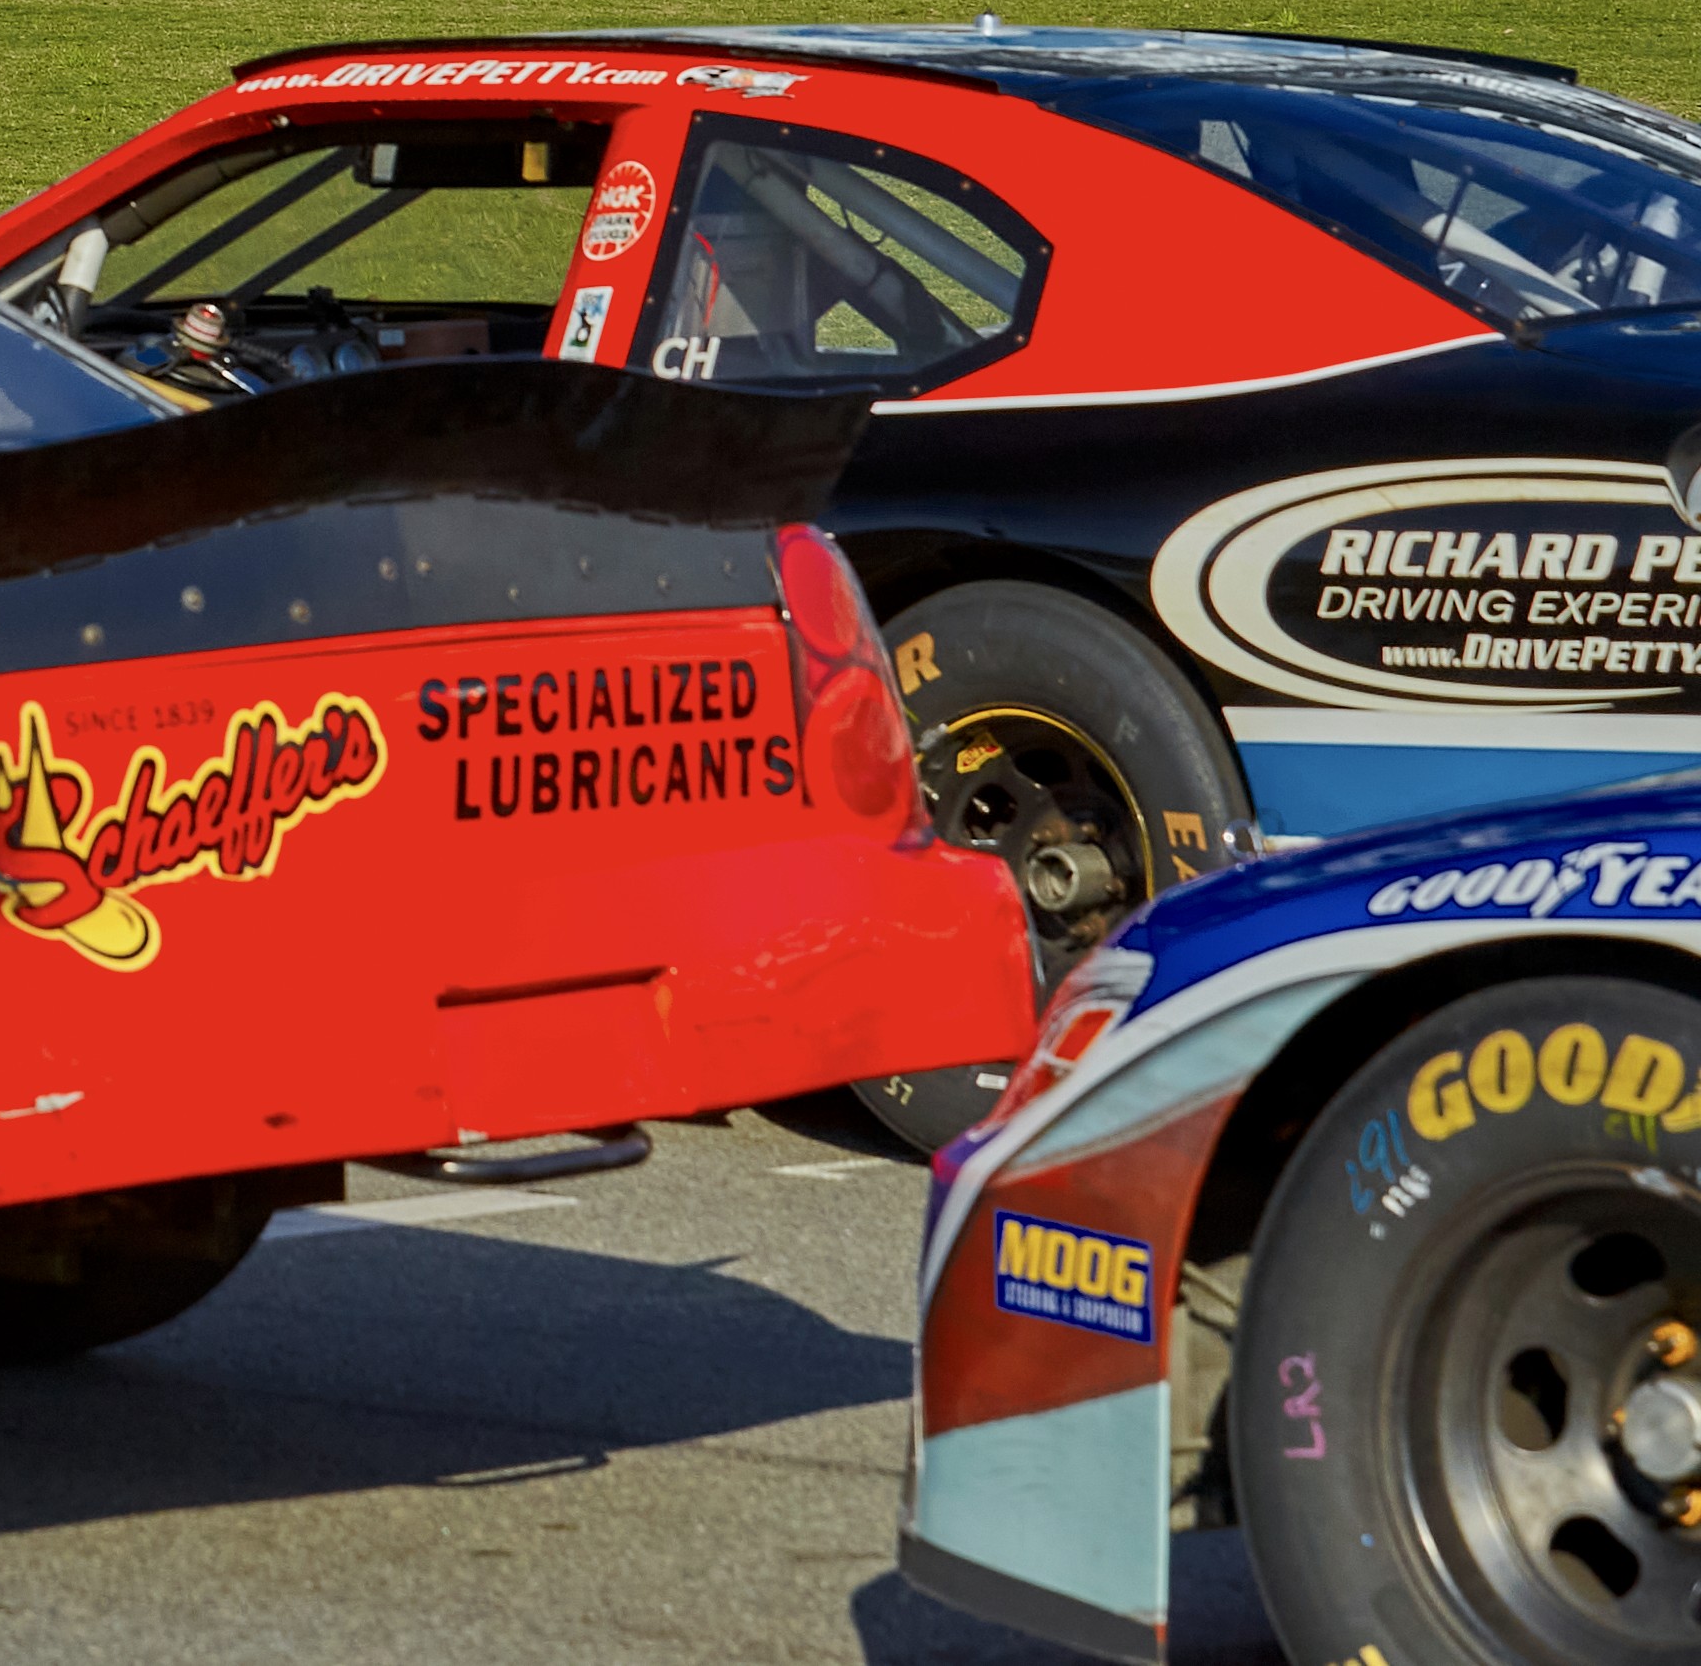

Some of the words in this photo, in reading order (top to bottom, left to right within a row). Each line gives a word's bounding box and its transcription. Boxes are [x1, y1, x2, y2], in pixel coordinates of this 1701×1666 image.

[599, 185, 645, 210] NGK
[651, 335, 721, 381] CH
[1320, 528, 1618, 582] RICHARD
[1316, 586, 1516, 624] DRIVING
[64, 706, 139, 738] SINCE
[416, 661, 757, 742] SPECIALIZED
[455, 735, 796, 822] LUBRICANTS
[999, 1218, 1148, 1309] MOOG
